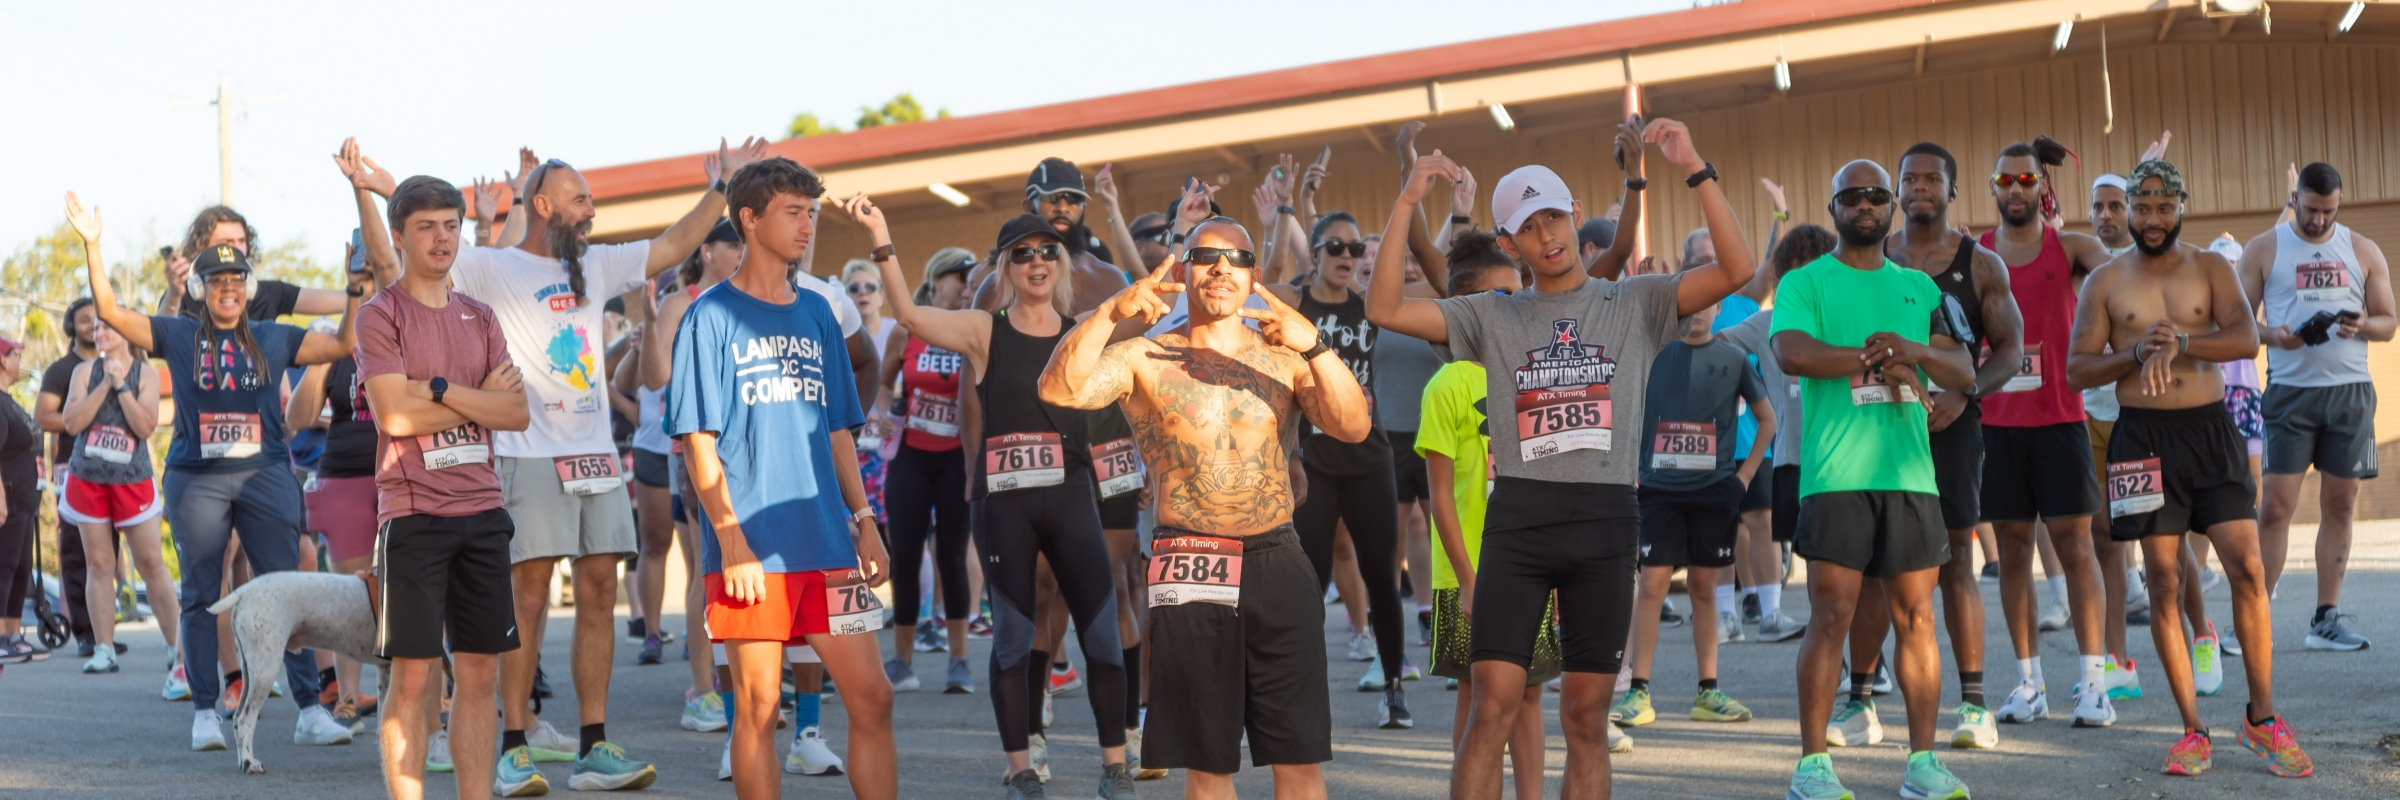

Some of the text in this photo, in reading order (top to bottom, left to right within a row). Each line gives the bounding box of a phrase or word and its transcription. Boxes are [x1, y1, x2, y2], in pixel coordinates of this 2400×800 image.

[2303, 272, 2342, 288] 7621
[1316, 314, 1374, 353] Hot
[780, 358, 800, 375] XC
[917, 353, 962, 373] BEEF
[1532, 357, 1600, 369] AMERICAN
[1537, 389, 1587, 402] ATX Timing
[917, 401, 957, 423] 7615
[1528, 402, 1601, 436] 7585
[207, 425, 253, 443] 7664
[432, 421, 482, 448] 7643
[1682, 423, 1702, 432] Timing
[94, 433, 129, 451] 7609
[1003, 433, 1042, 444] ATX Timing
[1106, 442, 1119, 451] ATX
[1661, 435, 1709, 453] 7589
[995, 446, 1055, 472] 7616
[1533, 446, 1559, 459] TIMING
[564, 457, 612, 478] 7655
[1102, 451, 1140, 478] 759
[2122, 462, 2144, 471] Timing
[2110, 473, 2154, 499] 7622
[1170, 538, 1219, 549] ATX Timing
[1158, 555, 1229, 583] 7584
[837, 584, 882, 613] 764
[840, 625, 867, 635] TIMING
